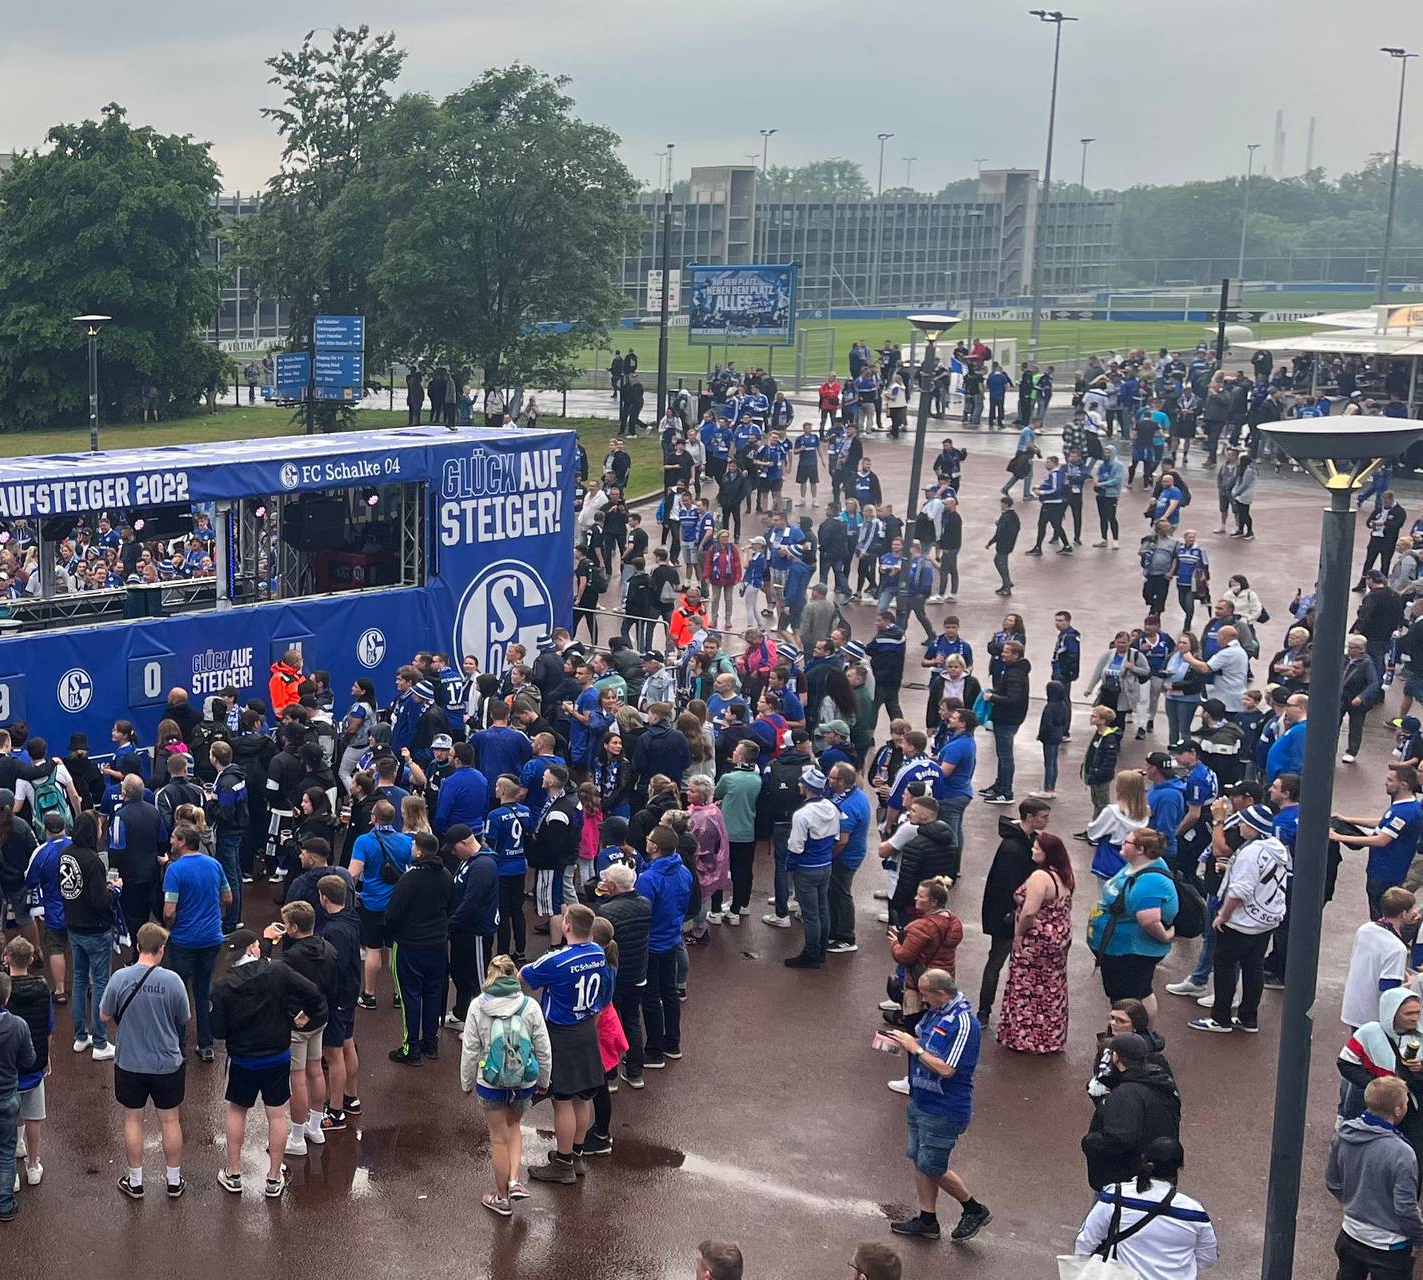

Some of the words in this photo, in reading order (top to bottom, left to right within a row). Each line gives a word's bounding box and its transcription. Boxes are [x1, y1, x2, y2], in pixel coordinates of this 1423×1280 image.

[716, 295, 754, 311] ALLES
[302, 465, 322, 483] FC
[326, 460, 381, 481] Schalke
[385, 458, 401, 475] 04
[442, 449, 518, 500] GLÜCK
[519, 448, 562, 492] AUF
[136, 472, 190, 509] 2022
[441, 490, 562, 547] STEIGER!
[192, 649, 230, 674] GLÜCK
[230, 647, 253, 668] AUF
[192, 665, 253, 695] STEIGER!
[447, 682, 463, 705] 17
[511, 818, 523, 848] 9
[572, 972, 602, 1012] 10
